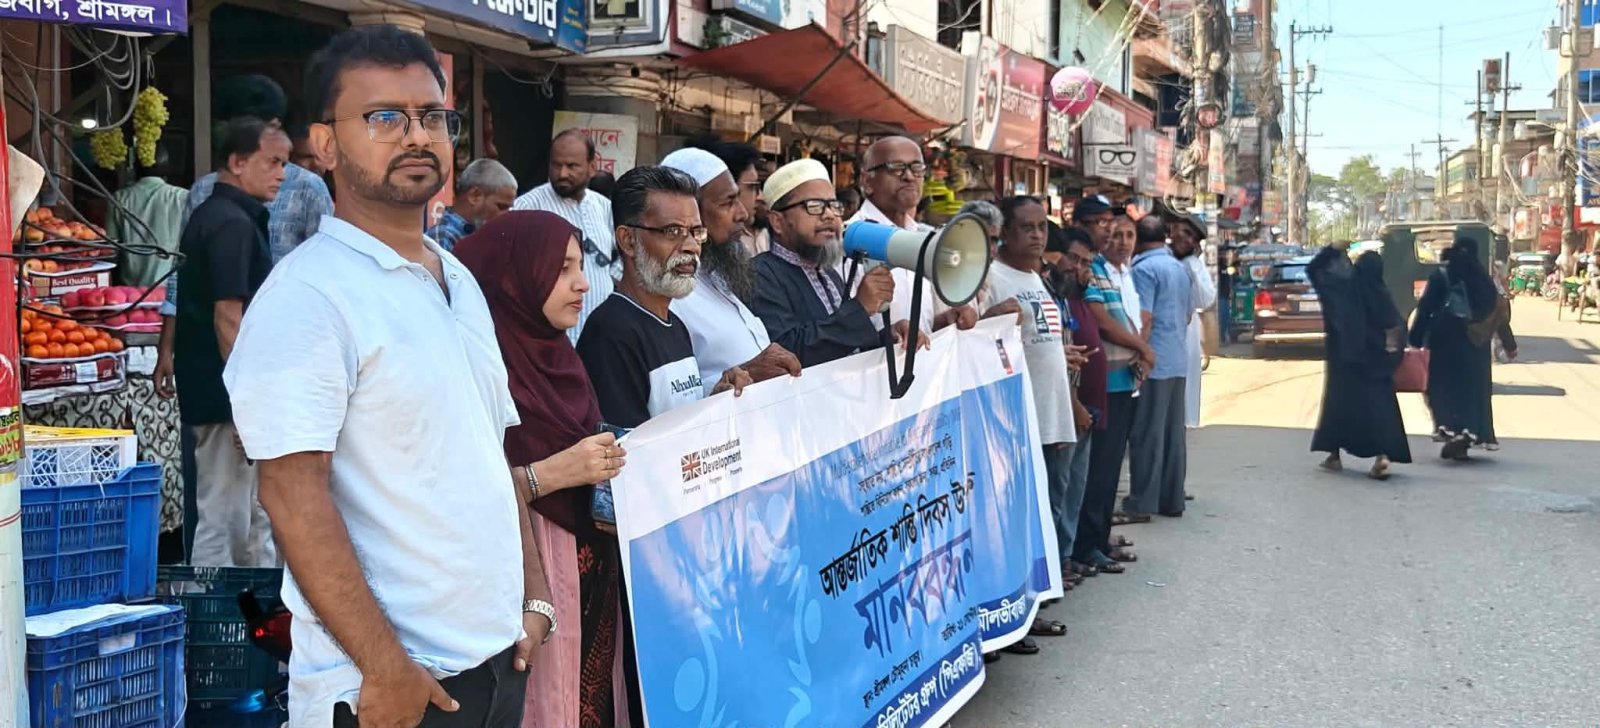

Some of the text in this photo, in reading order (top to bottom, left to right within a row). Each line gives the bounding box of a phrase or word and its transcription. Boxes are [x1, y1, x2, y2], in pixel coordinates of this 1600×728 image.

[52, 276, 96, 286] Best Quality
[701, 439, 740, 460] UK International
[702, 449, 742, 475] Development
[819, 494, 952, 599] আন্তর্জাতিক শান্তি দিবস
[854, 527, 974, 658] মানববন্ধন
[920, 675, 938, 707] গ্রুপ
